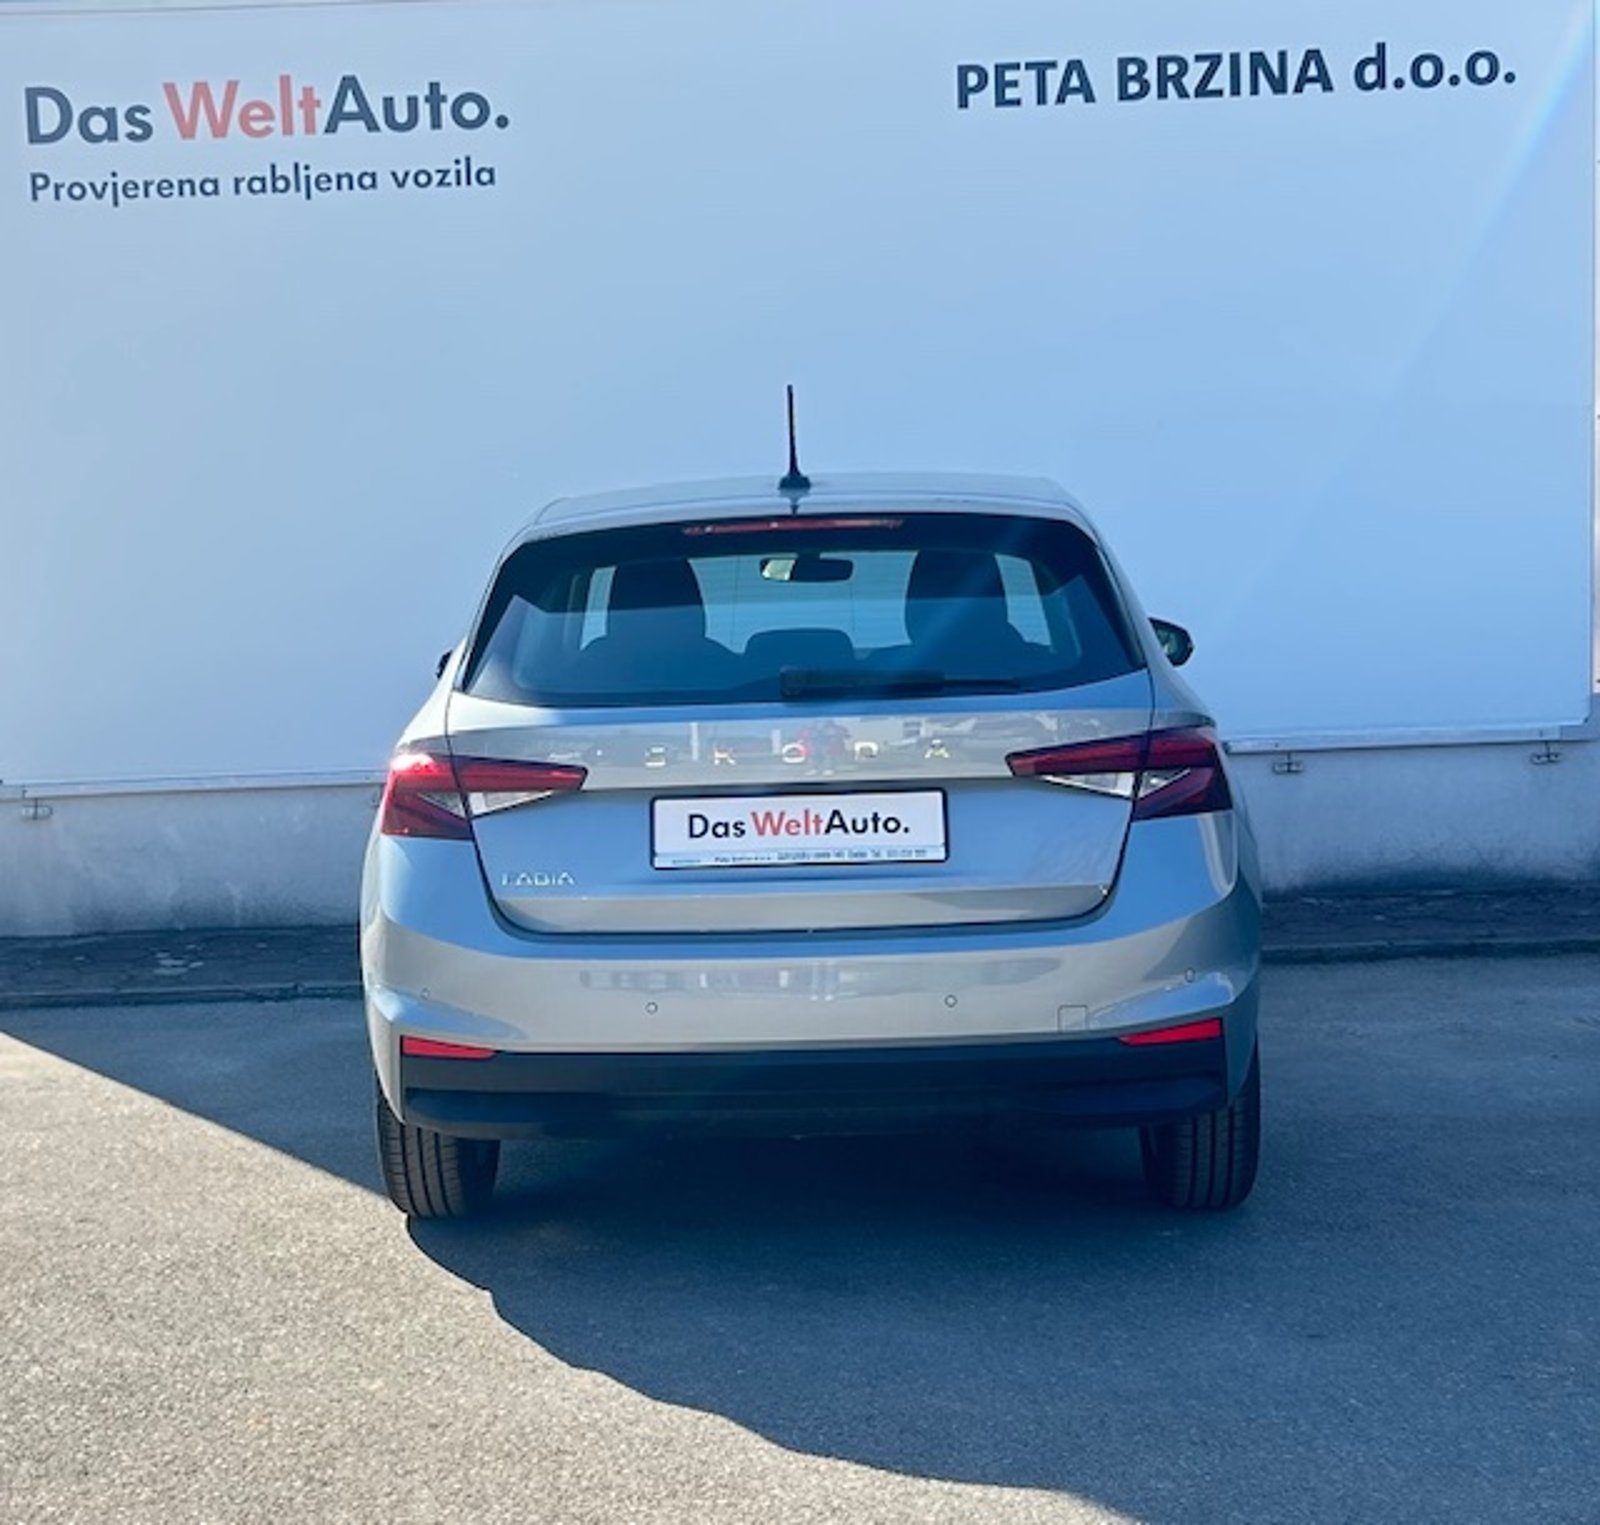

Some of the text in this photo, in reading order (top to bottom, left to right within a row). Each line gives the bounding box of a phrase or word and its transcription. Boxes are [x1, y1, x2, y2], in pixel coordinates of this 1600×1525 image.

[956, 42, 1516, 109] PETA BRZINA d.o.o.
[25, 74, 510, 144] Das WeltAuto.
[29, 156, 496, 207] Provjerena rabljena vozila
[688, 809, 910, 838] Das WeltAuto.
